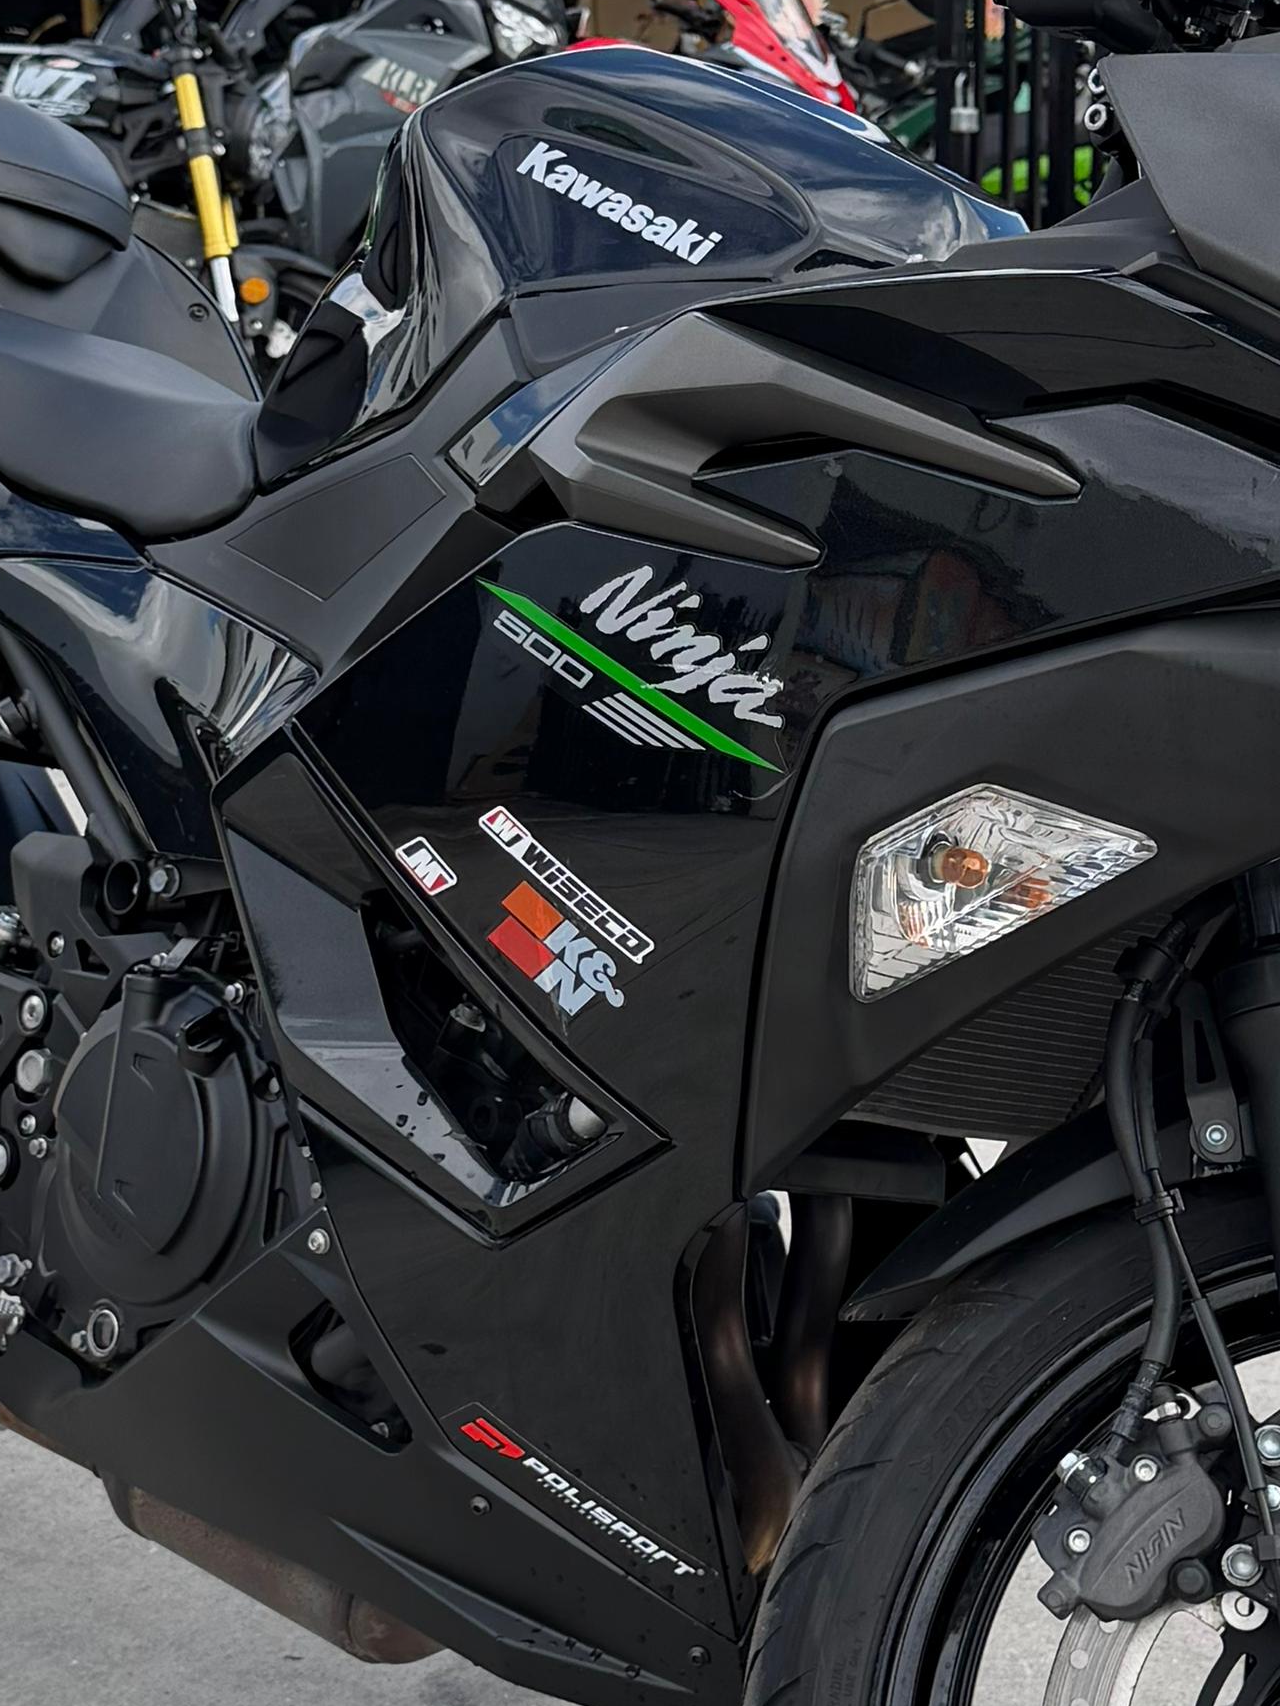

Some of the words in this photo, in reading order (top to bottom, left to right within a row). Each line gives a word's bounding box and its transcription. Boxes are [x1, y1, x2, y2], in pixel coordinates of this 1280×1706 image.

[516, 141, 723, 265] Kawasaki
[493, 610, 593, 689] 500
[579, 565, 785, 729] Ninja
[523, 1457, 695, 1575] POLISPORT
